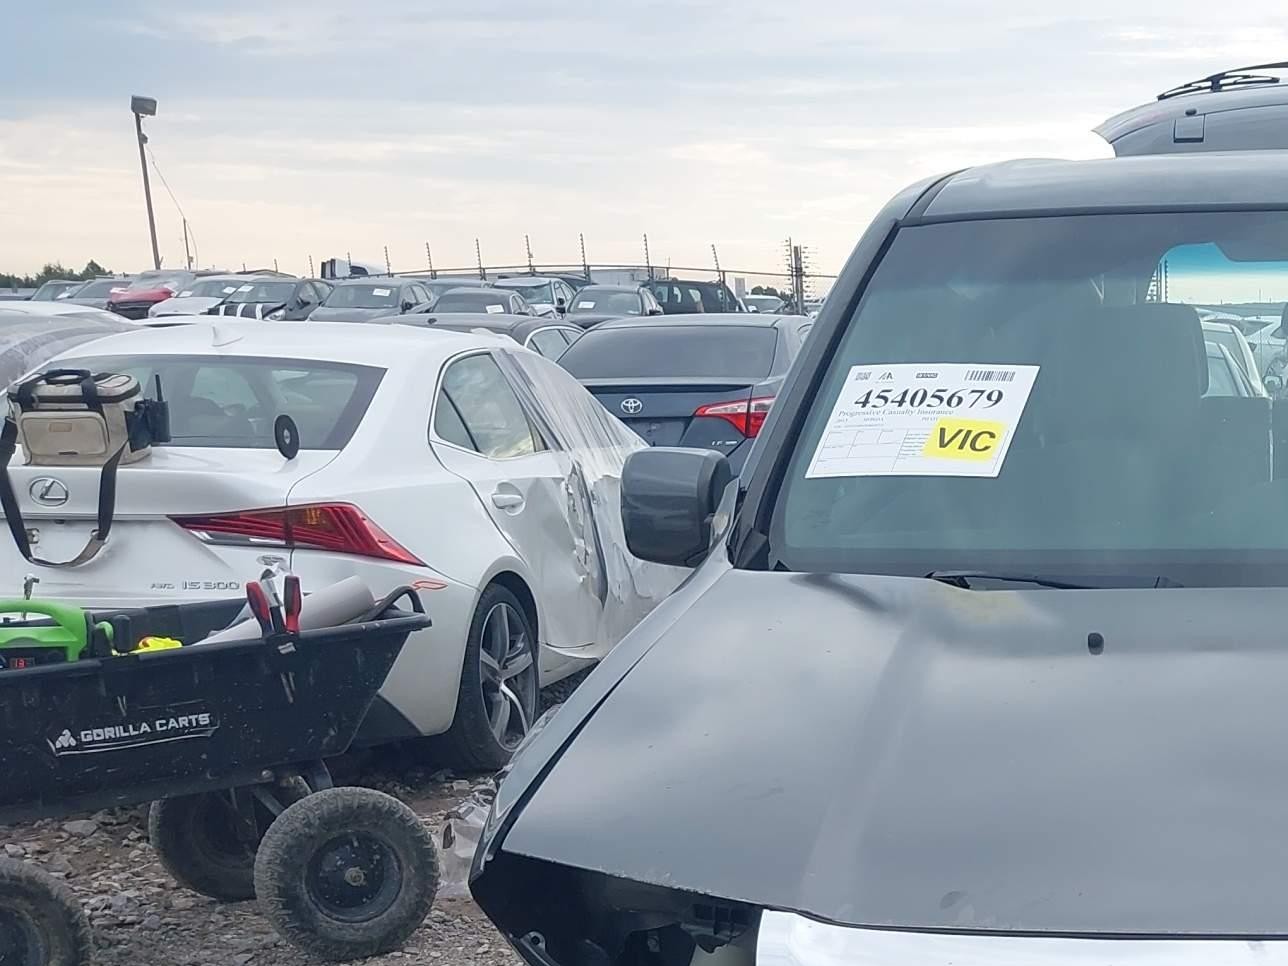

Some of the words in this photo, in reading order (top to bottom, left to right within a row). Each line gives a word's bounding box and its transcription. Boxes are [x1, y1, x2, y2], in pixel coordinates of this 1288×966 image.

[854, 387, 1004, 409] 45405679
[838, 409, 881, 418] Progressive
[937, 427, 996, 453] VIC
[203, 580, 240, 590] 300
[80, 722, 151, 743] GORILLA
[155, 712, 211, 732] CARTS
